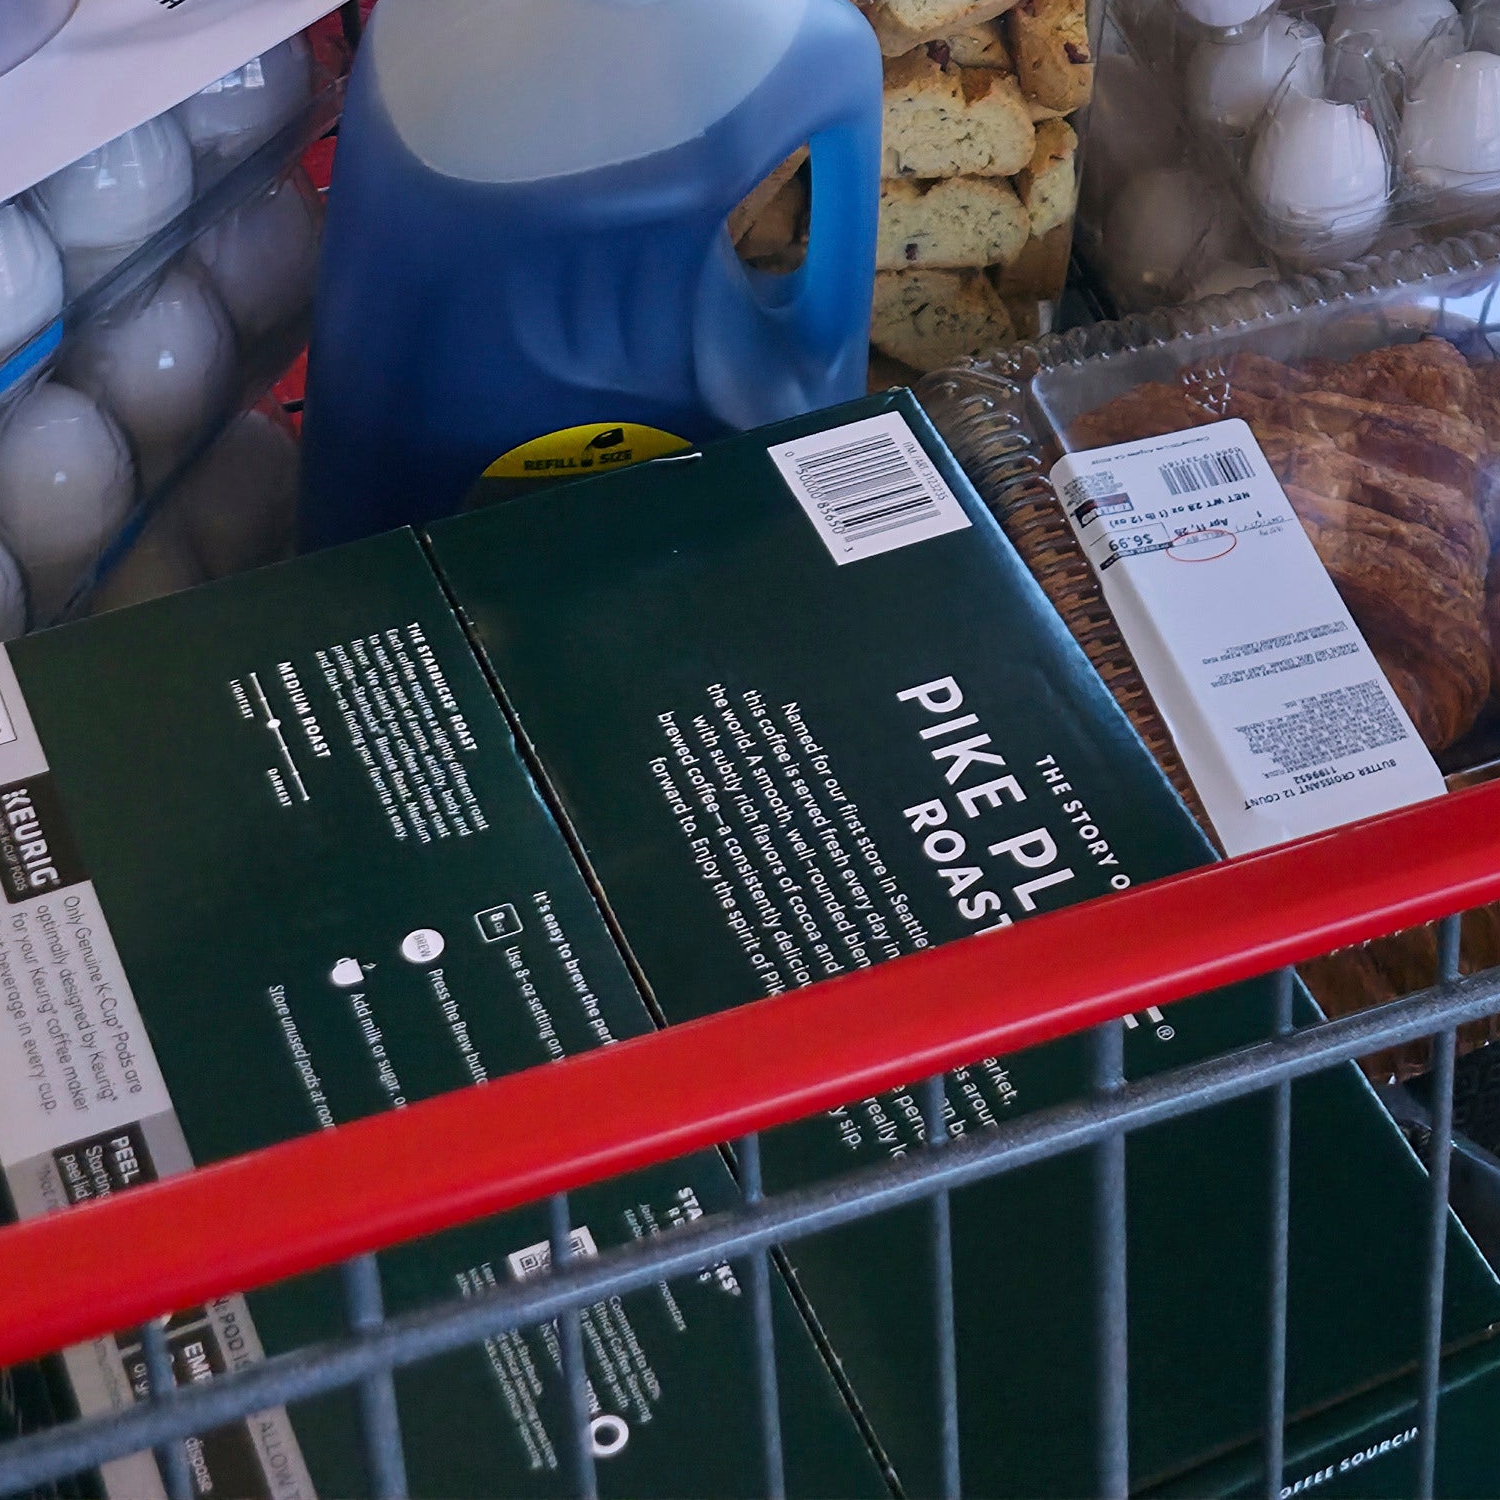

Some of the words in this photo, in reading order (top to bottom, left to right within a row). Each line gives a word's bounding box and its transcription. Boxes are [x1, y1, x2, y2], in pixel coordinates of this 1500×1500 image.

[522, 456, 578, 471] REFILL
[596, 448, 633, 465] SIZE
[1107, 534, 1155, 552] $6.99
[405, 621, 426, 644] THE
[448, 713, 478, 751] ROAST
[705, 682, 729, 708] the
[741, 688, 767, 718] this
[276, 660, 312, 715] MEDIUM
[300, 715, 332, 757] ROAST
[691, 713, 721, 748] with
[720, 707, 757, 754] world.
[757, 717, 791, 763] coffee
[896, 674, 1027, 821] PIKE
[708, 748, 743, 791] subtly
[743, 754, 763, 767] A
[782, 761, 800, 778] is
[732, 792, 761, 824] rich
[751, 766, 794, 828] smooth,
[790, 777, 832, 828] served
[1034, 753, 1073, 796] THE
[1061, 798, 1120, 866] STORY
[0, 787, 60, 887] KEURIG
[780, 700, 824, 754] Named
[809, 753, 833, 775] for
[823, 777, 847, 802] our
[837, 802, 866, 836] first
[855, 835, 887, 876] store
[877, 874, 897, 894] in
[889, 892, 936, 949] Seattle'
[748, 822, 787, 876] flavors
[817, 826, 851, 868] fresh
[777, 876, 802, 893] of
[785, 827, 857, 932] well-rounded
[901, 800, 1013, 938] ROAST
[531, 889, 551, 913] It's
[840, 868, 874, 910] every
[61, 894, 86, 925] Only
[787, 894, 822, 942] cocoa
[865, 911, 891, 940] day
[541, 912, 565, 943] easy
[73, 926, 103, 983] Genuine
[555, 942, 572, 959] to
[812, 942, 845, 974] and
[842, 930, 871, 968] blen
[881, 940, 901, 959] in
[426, 967, 451, 1001] Press
[563, 957, 589, 993] brew
[441, 999, 460, 1022] the
[580, 992, 600, 1018] the
[450, 1020, 474, 1053] Brew
[588, 1017, 619, 1046] perf
[110, 1030, 136, 1069] Pods
[123, 1068, 143, 1094] are
[464, 1050, 488, 1085] butto
[109, 1134, 140, 1184] PEEL
